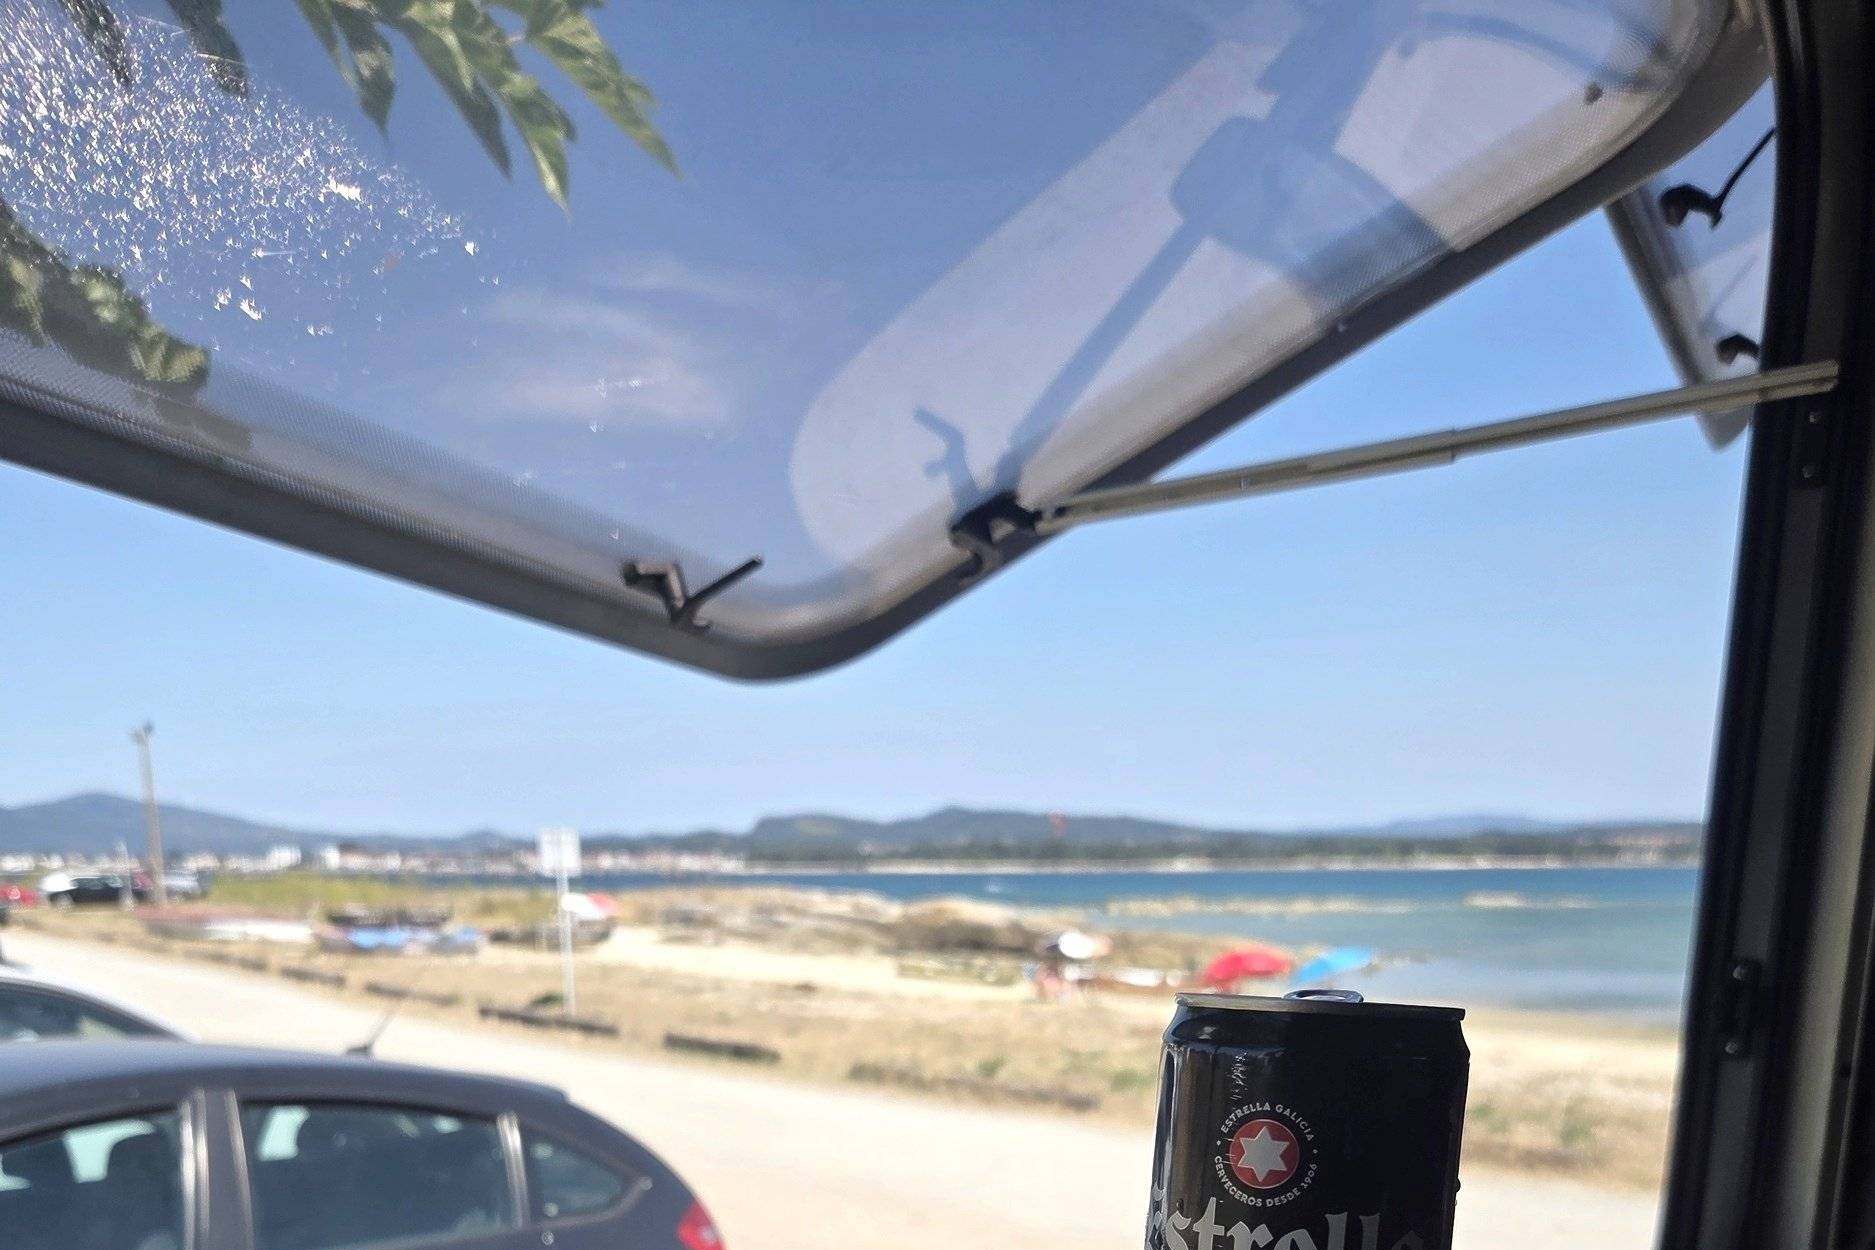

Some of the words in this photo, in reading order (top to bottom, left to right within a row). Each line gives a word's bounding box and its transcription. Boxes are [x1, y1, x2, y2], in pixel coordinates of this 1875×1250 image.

[1221, 1102, 1271, 1134] ESTRELLA
[1275, 1104, 1315, 1141] GALICIA
[1214, 1155, 1263, 1207] CERVECEROS
[1265, 1187, 1301, 1207] DESDE
[1301, 1163, 1318, 1189] 1906
